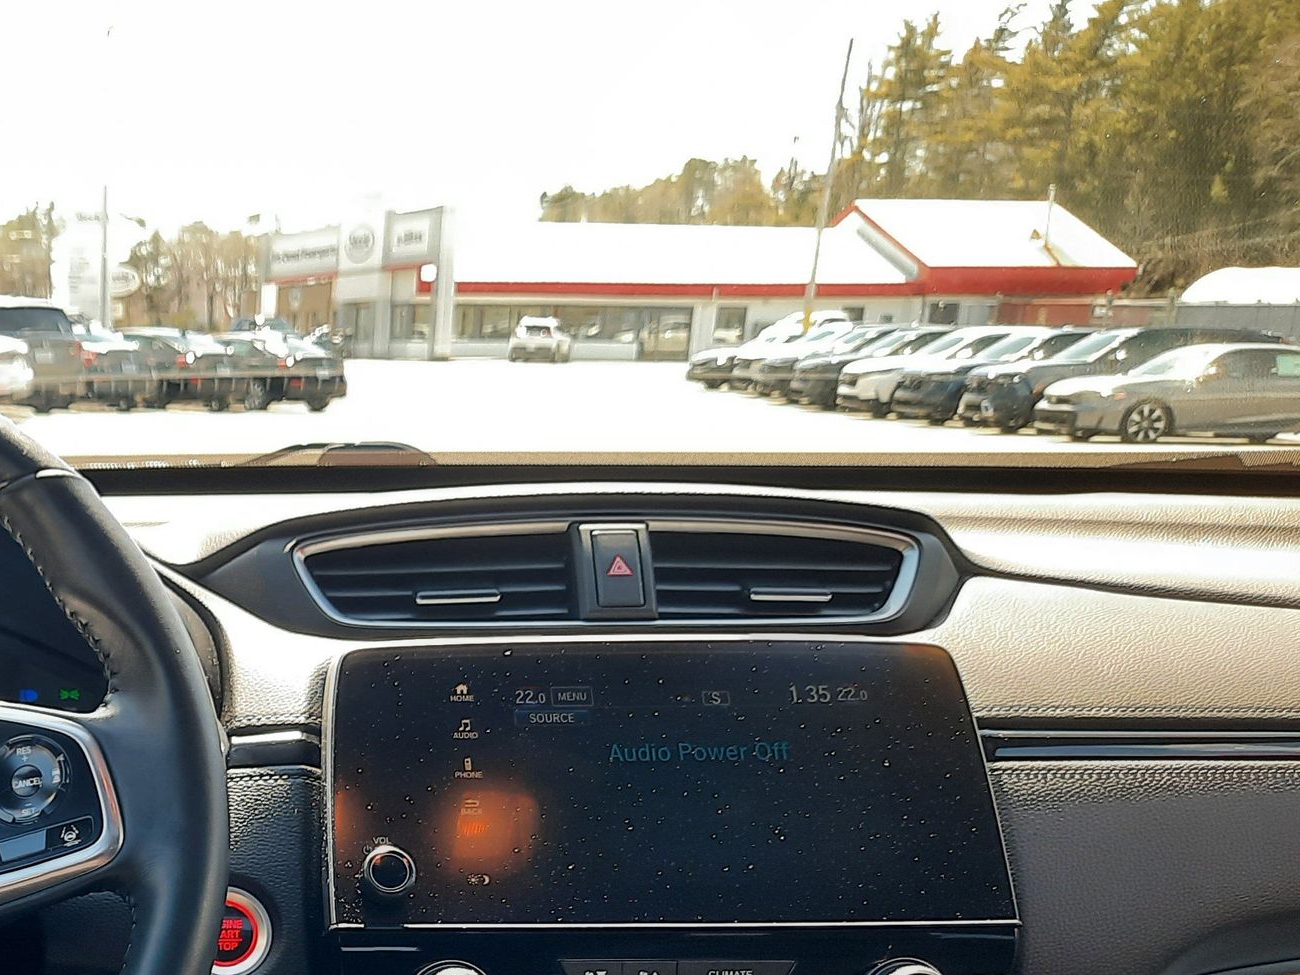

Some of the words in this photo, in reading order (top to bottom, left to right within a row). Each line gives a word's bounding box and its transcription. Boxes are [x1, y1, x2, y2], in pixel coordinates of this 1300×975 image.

[450, 694, 474, 702] HOME
[515, 690, 546, 704] 22.0
[558, 691, 588, 702] MENU
[529, 713, 575, 724] SOURCE
[453, 731, 478, 739] AUDIO
[16, 747, 32, 756] RES
[609, 743, 671, 762] Audio
[679, 743, 747, 762] Power
[755, 741, 790, 761] Off
[455, 771, 483, 779] PHONE
[12, 776, 43, 788] CANCEL
[373, 837, 392, 845] VOL
